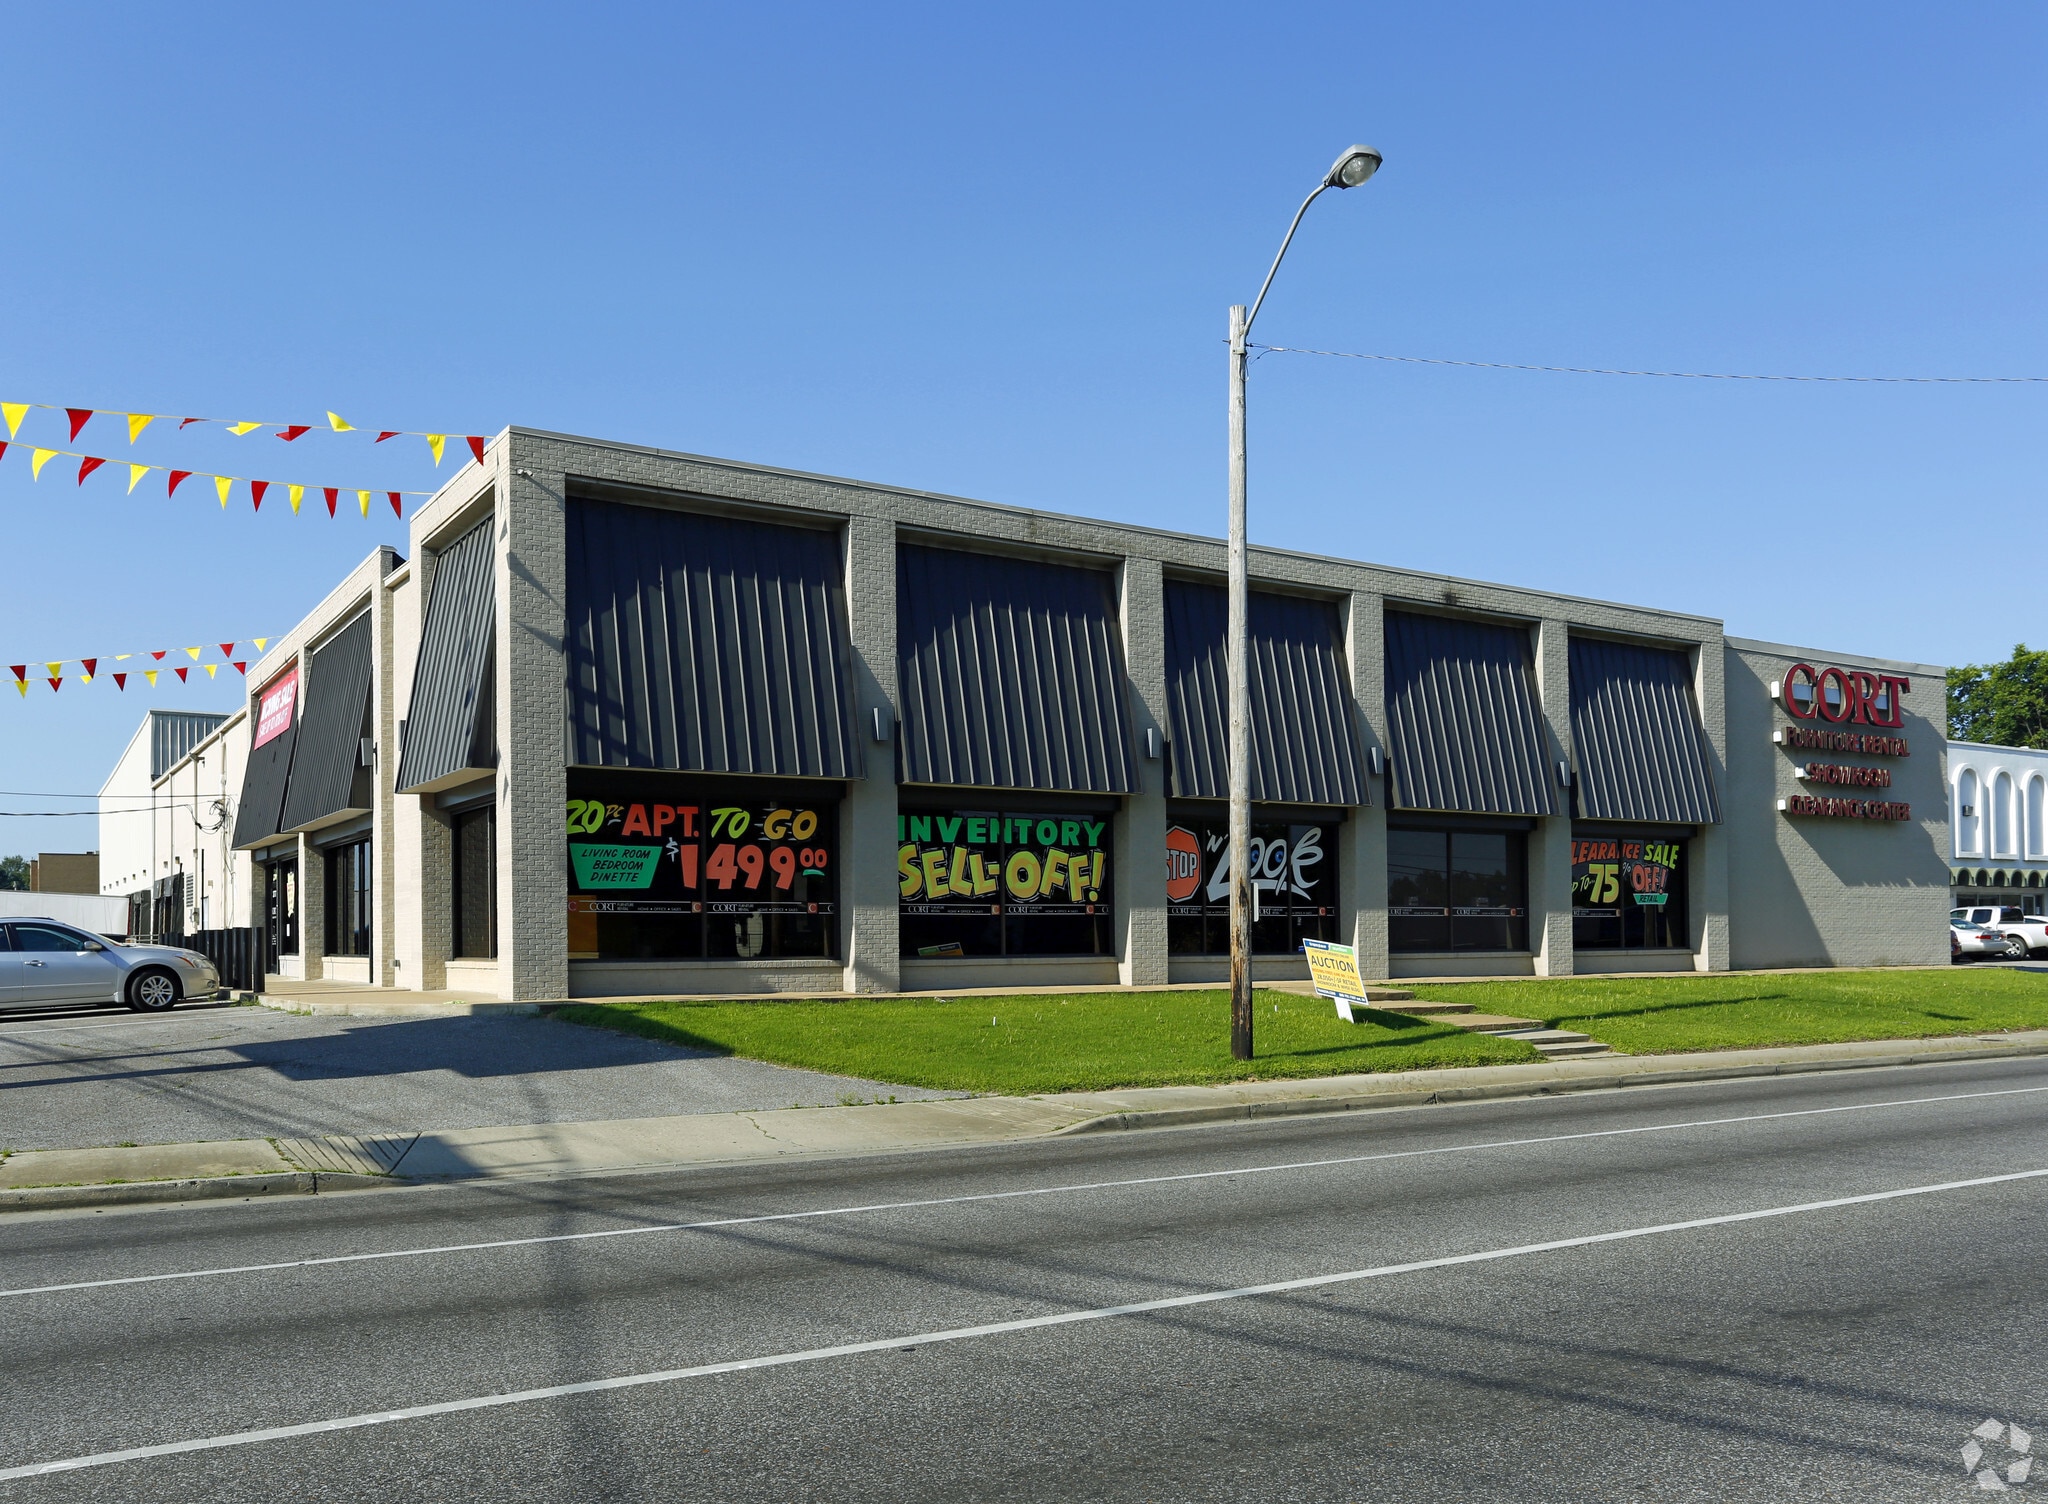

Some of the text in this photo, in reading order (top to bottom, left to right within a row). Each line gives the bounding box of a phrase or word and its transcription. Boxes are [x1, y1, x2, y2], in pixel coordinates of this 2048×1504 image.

[280, 680, 295, 709] SALE
[1782, 663, 1911, 728] CORT
[1784, 726, 1910, 757] FURNITURE RENTAL
[1808, 762, 1891, 787] SHOWROOM
[566, 799, 605, 835] 20
[621, 803, 699, 838] APT.
[710, 807, 751, 839] TO
[763, 809, 818, 841] GO
[1788, 795, 1911, 821] CLEARANCE CENTER
[898, 815, 1106, 847] INVENTORY
[581, 848, 651, 859] LIVING ROOM
[592, 859, 644, 871] BEDROOM
[1571, 841, 1679, 870] LEARACE SALE
[590, 872, 639, 882] DINETTE
[1631, 863, 1667, 894] OFF!
[589, 902, 617, 911] CORT
[712, 903, 738, 912] CORT
[1639, 894, 1659, 903] RETAIL
[1312, 955, 1354, 973] AUCTION
